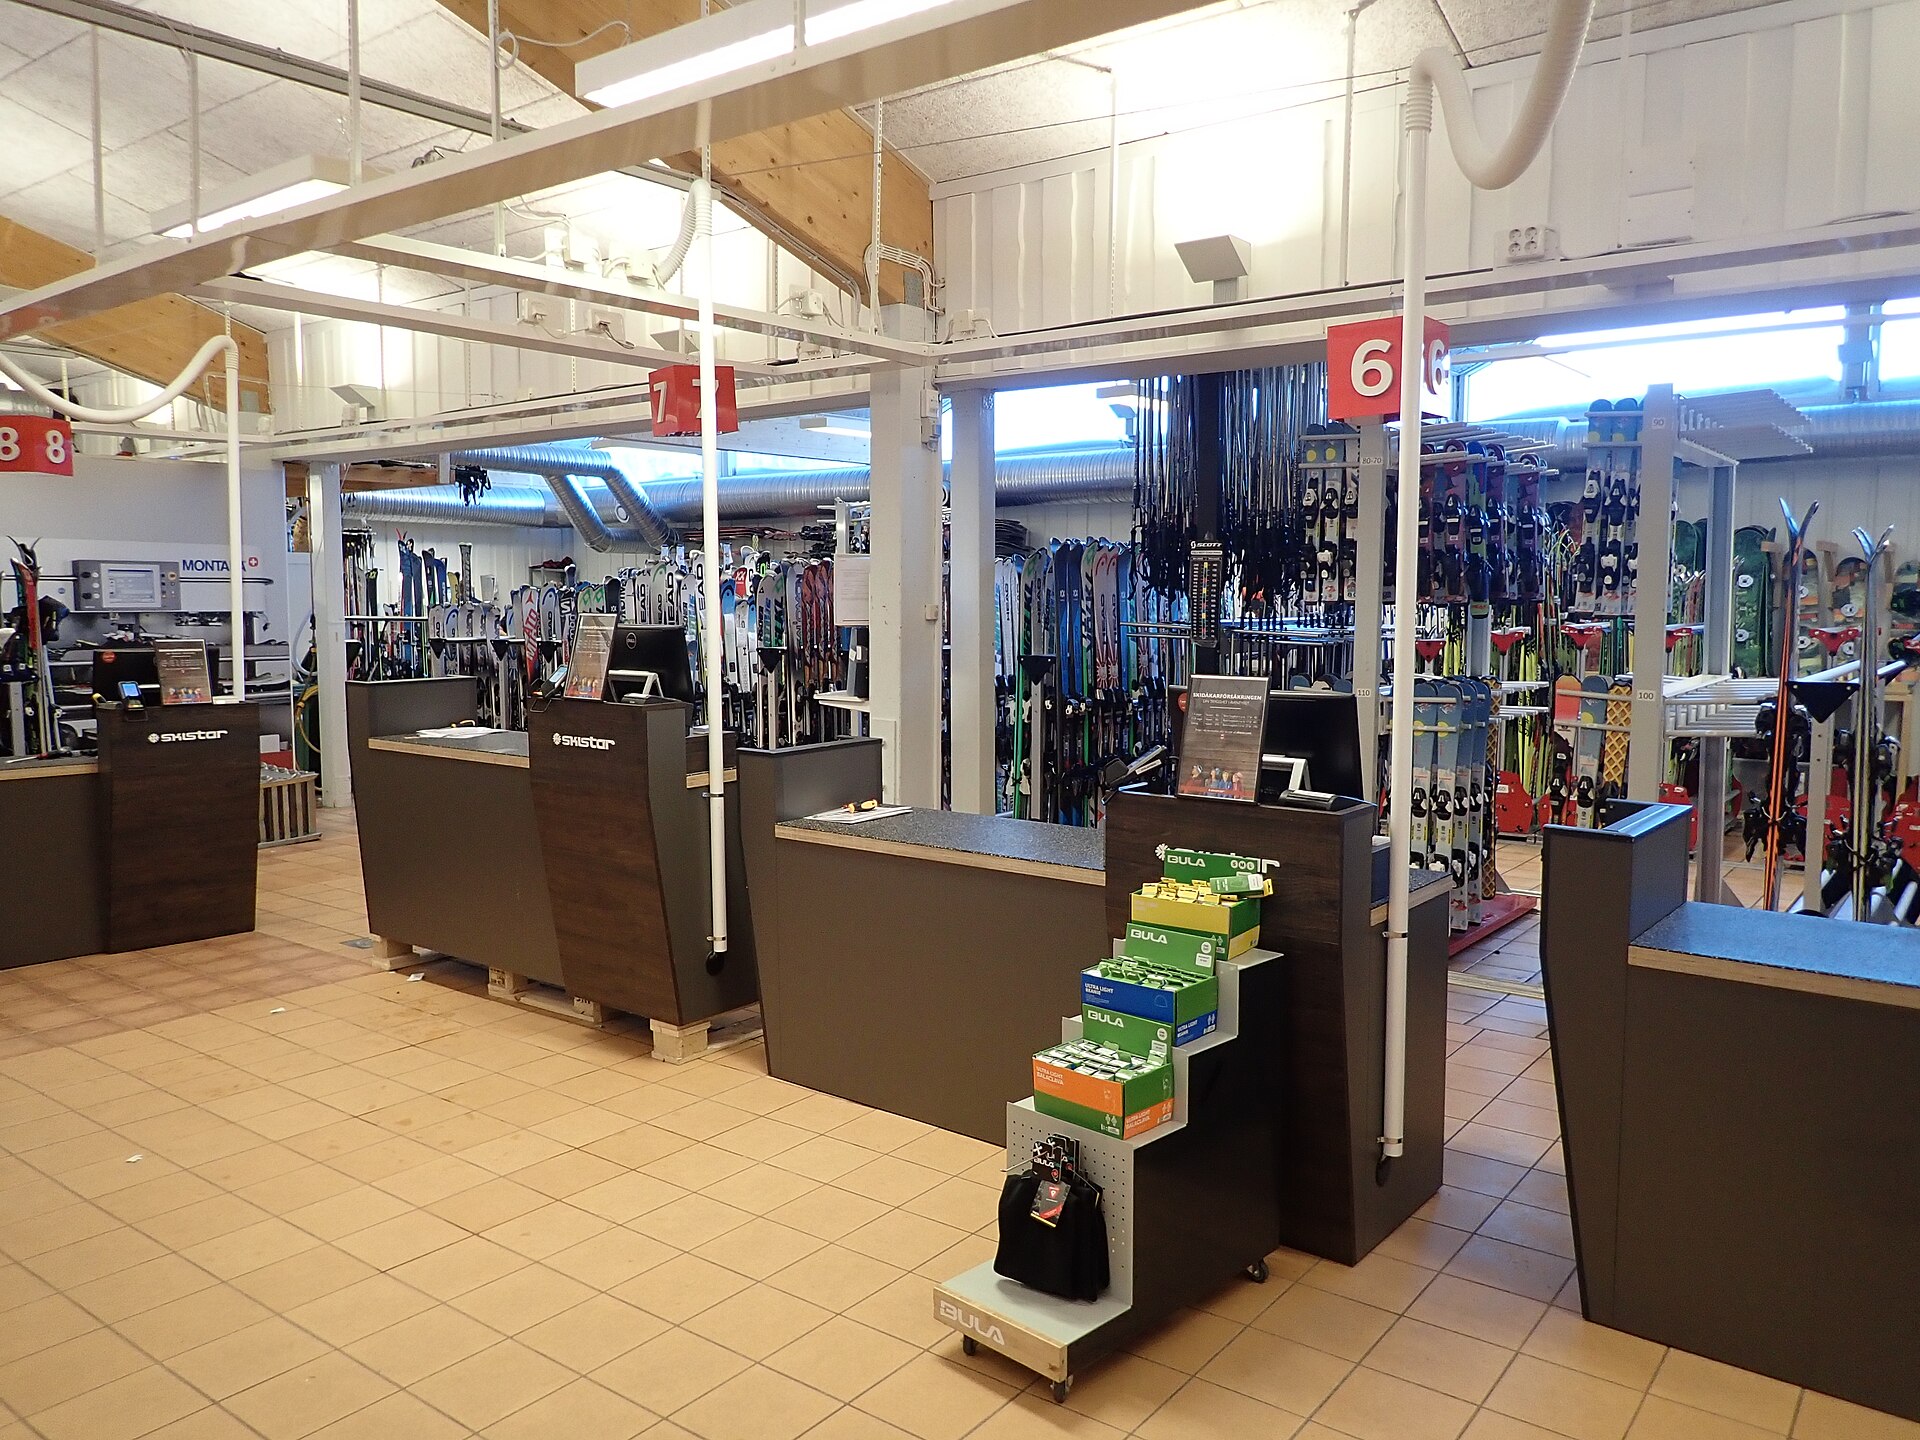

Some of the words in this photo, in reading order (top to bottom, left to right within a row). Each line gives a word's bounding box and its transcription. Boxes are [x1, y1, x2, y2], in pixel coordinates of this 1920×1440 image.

[1351, 339, 1394, 397] 6
[1428, 339, 1445, 394] 6
[653, 381, 668, 423] 7
[1653, 419, 1665, 427] 90
[0, 427, 21, 461] 8
[45, 429, 66, 464] 8
[1362, 457, 1382, 465] 80-70
[182, 559, 247, 572] MONTAA
[1167, 855, 1206, 867] BULA
[1131, 929, 1168, 944] BULA
[1100, 986, 1114, 994] LIGHT
[1088, 1010, 1124, 1028] BULA
[940, 1300, 1005, 1345] BULA
